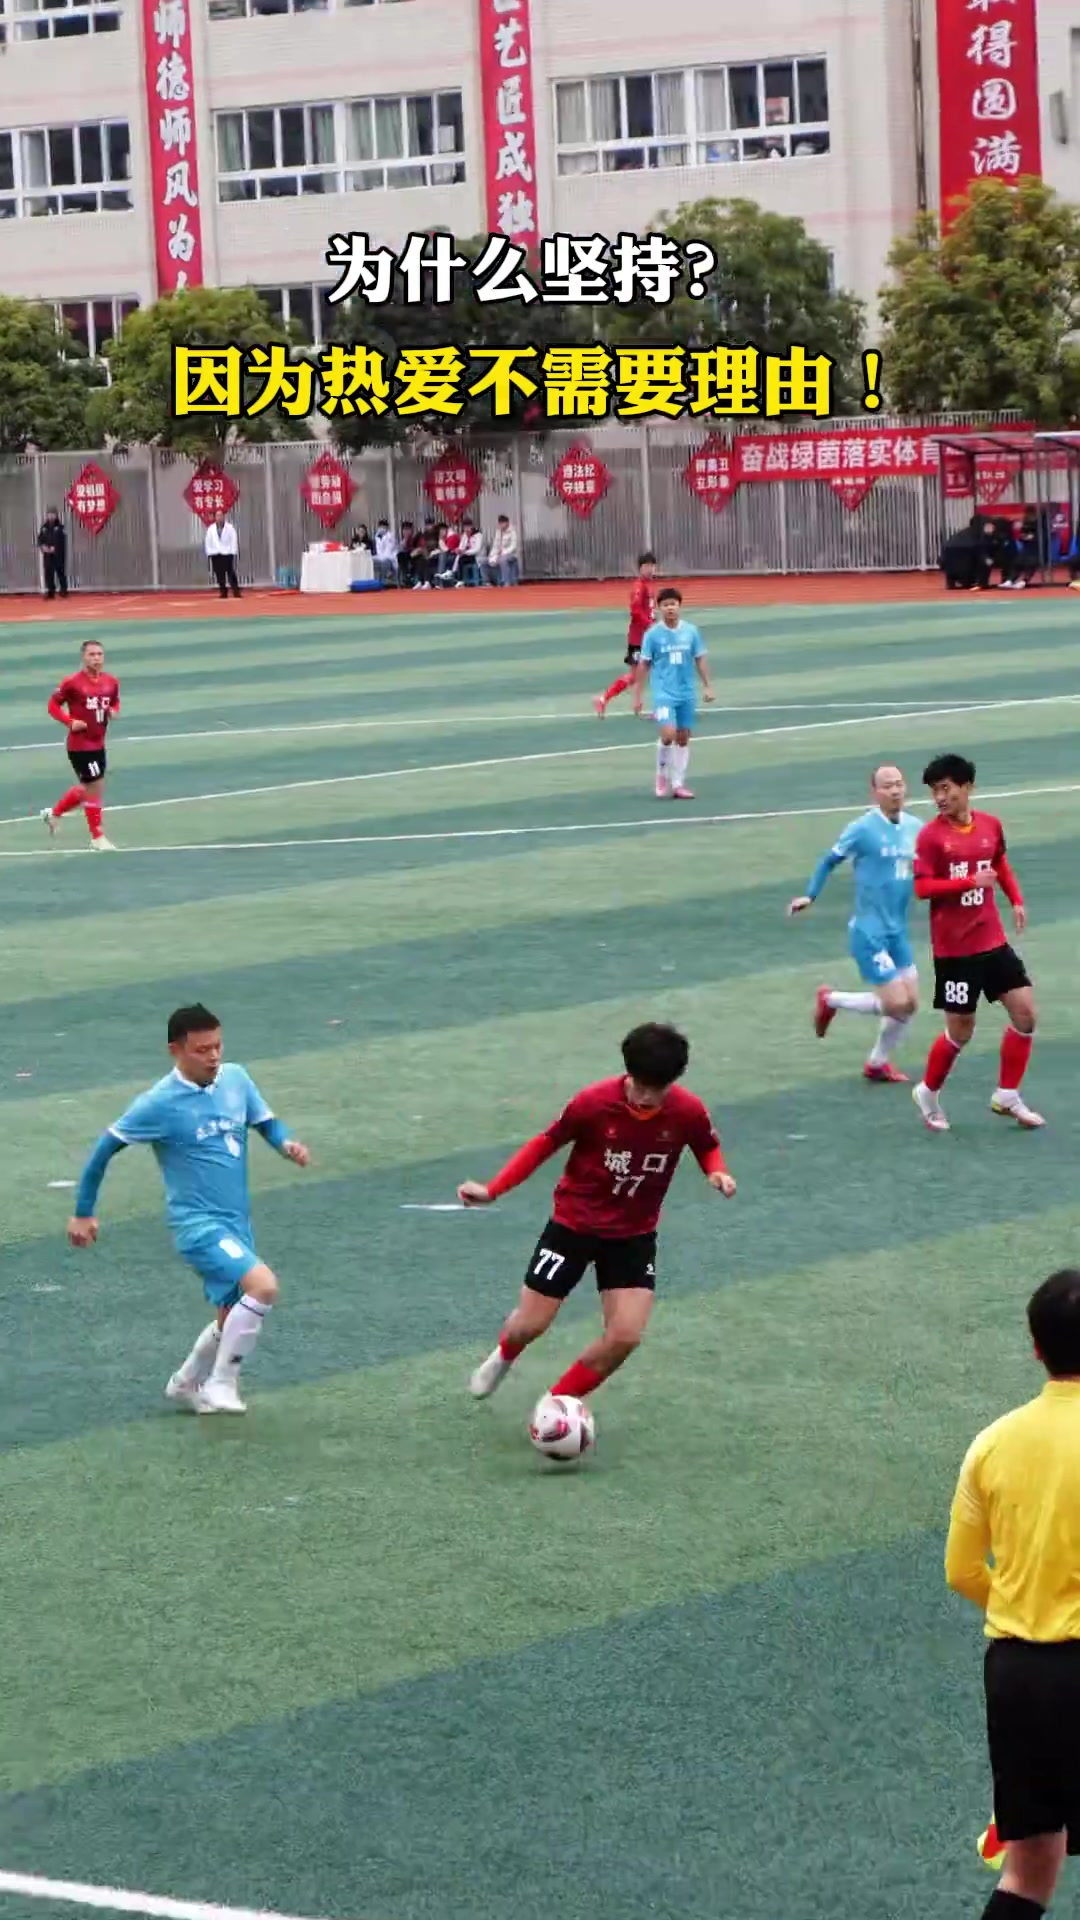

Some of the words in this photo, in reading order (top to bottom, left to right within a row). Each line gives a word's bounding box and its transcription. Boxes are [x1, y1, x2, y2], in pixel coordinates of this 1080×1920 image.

[153, 0, 199, 291] 师德师风为
[193, 479, 223, 493] 爱学习
[88, 760, 101, 777] 11
[945, 980, 969, 1004] 88
[604, 1149, 668, 1175] 城口
[612, 1174, 646, 1199] 77
[533, 1248, 566, 1281] 77
